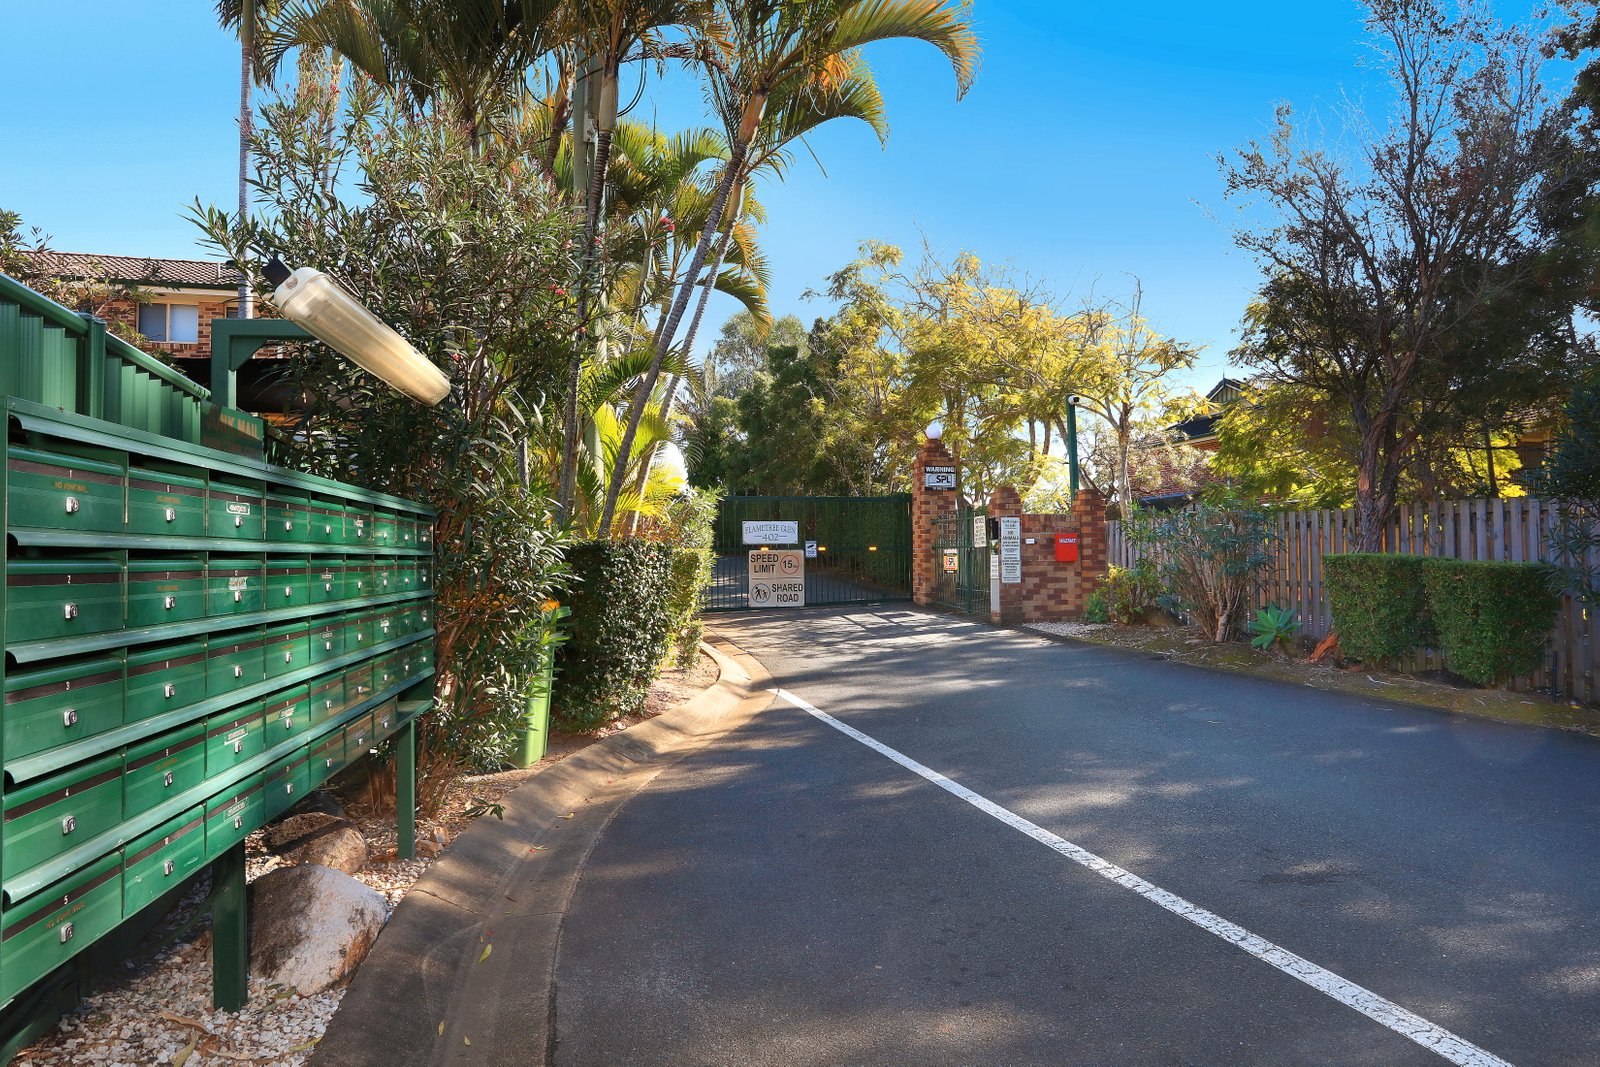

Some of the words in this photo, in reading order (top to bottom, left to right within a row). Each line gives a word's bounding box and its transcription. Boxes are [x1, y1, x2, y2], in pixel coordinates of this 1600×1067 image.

[237, 417, 260, 443] MAIL
[936, 475, 951, 484] SPL
[745, 525, 780, 534] FLAMETREE
[780, 525, 796, 534] GLEN
[750, 554, 778, 563] SPEED
[754, 565, 776, 573] LIMIT
[782, 560, 793, 569] 15
[772, 584, 803, 592] SHARED
[777, 594, 799, 602] ROAD
[65, 681, 70, 691] 3
[63, 894, 69, 905] 5
